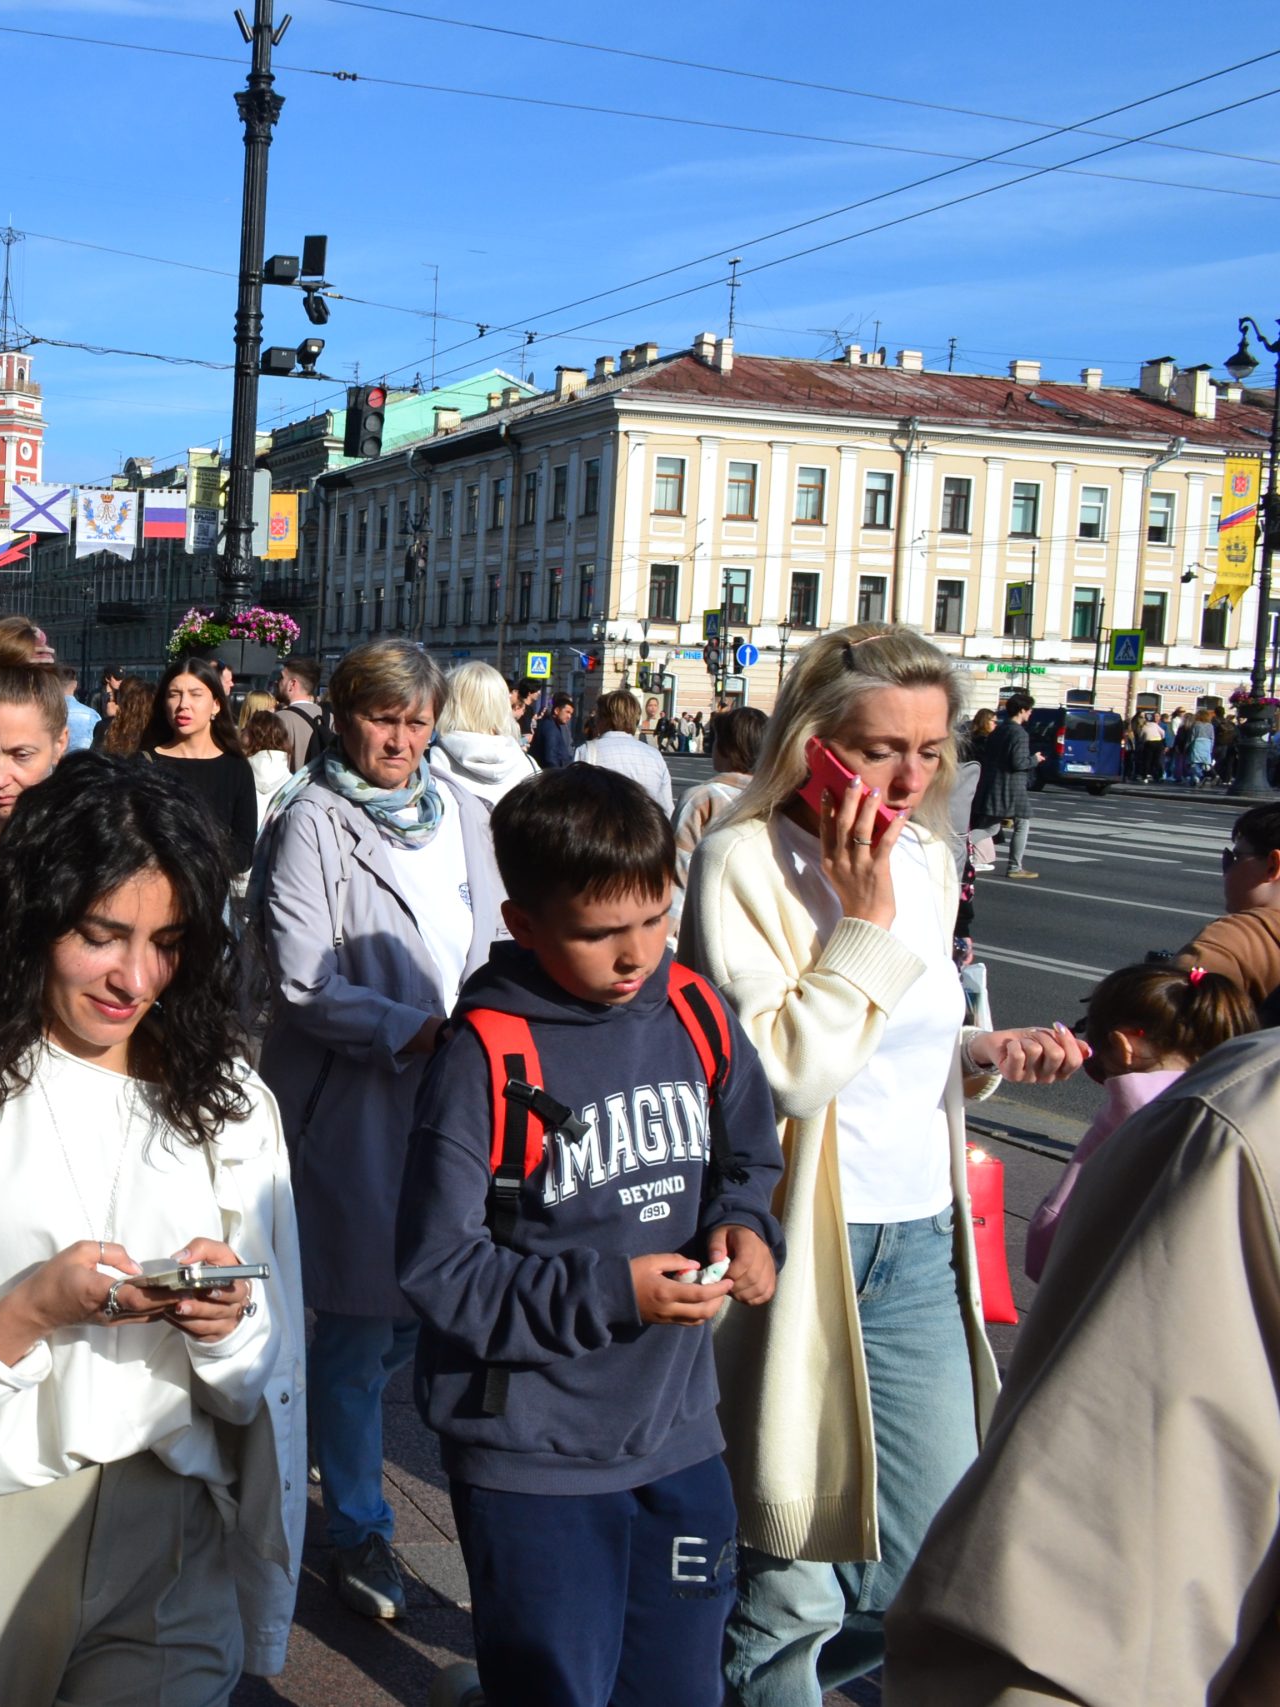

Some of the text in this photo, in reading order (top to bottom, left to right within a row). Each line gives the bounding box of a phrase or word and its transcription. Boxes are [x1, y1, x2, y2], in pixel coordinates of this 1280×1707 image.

[542, 1081, 711, 1208] IMAGIN
[618, 1175, 686, 1206] BEYOND
[642, 1204, 666, 1220] 1991
